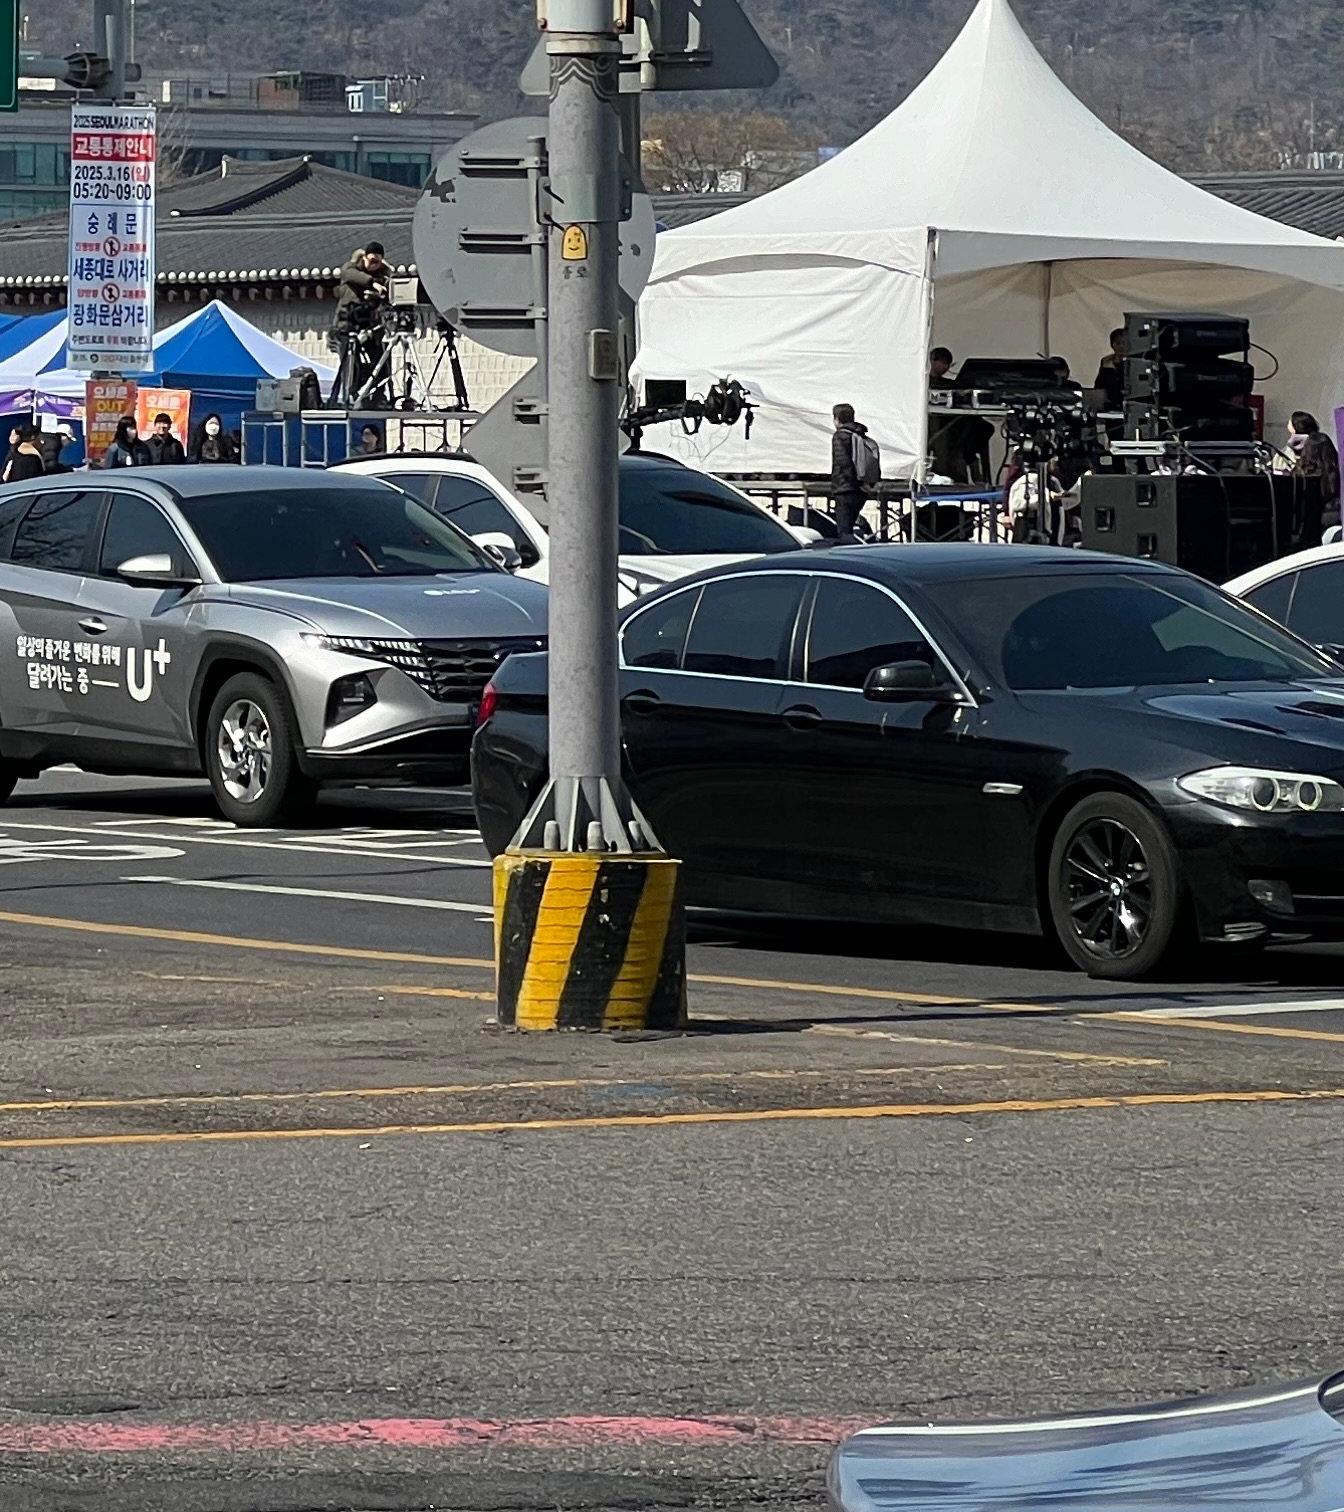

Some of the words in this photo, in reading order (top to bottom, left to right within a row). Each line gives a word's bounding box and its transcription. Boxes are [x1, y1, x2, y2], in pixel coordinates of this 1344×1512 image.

[73, 257, 114, 281] 세종대로
[118, 258, 149, 282] 사거리
[73, 303, 149, 328] 광화문삼거리
[16, 635, 44, 658] 일상의
[44, 638, 71, 662] 즐거운
[74, 641, 100, 665] 변화를
[102, 645, 121, 666] 위해
[27, 662, 73, 692] 달려가는
[77, 667, 89, 695] 중
